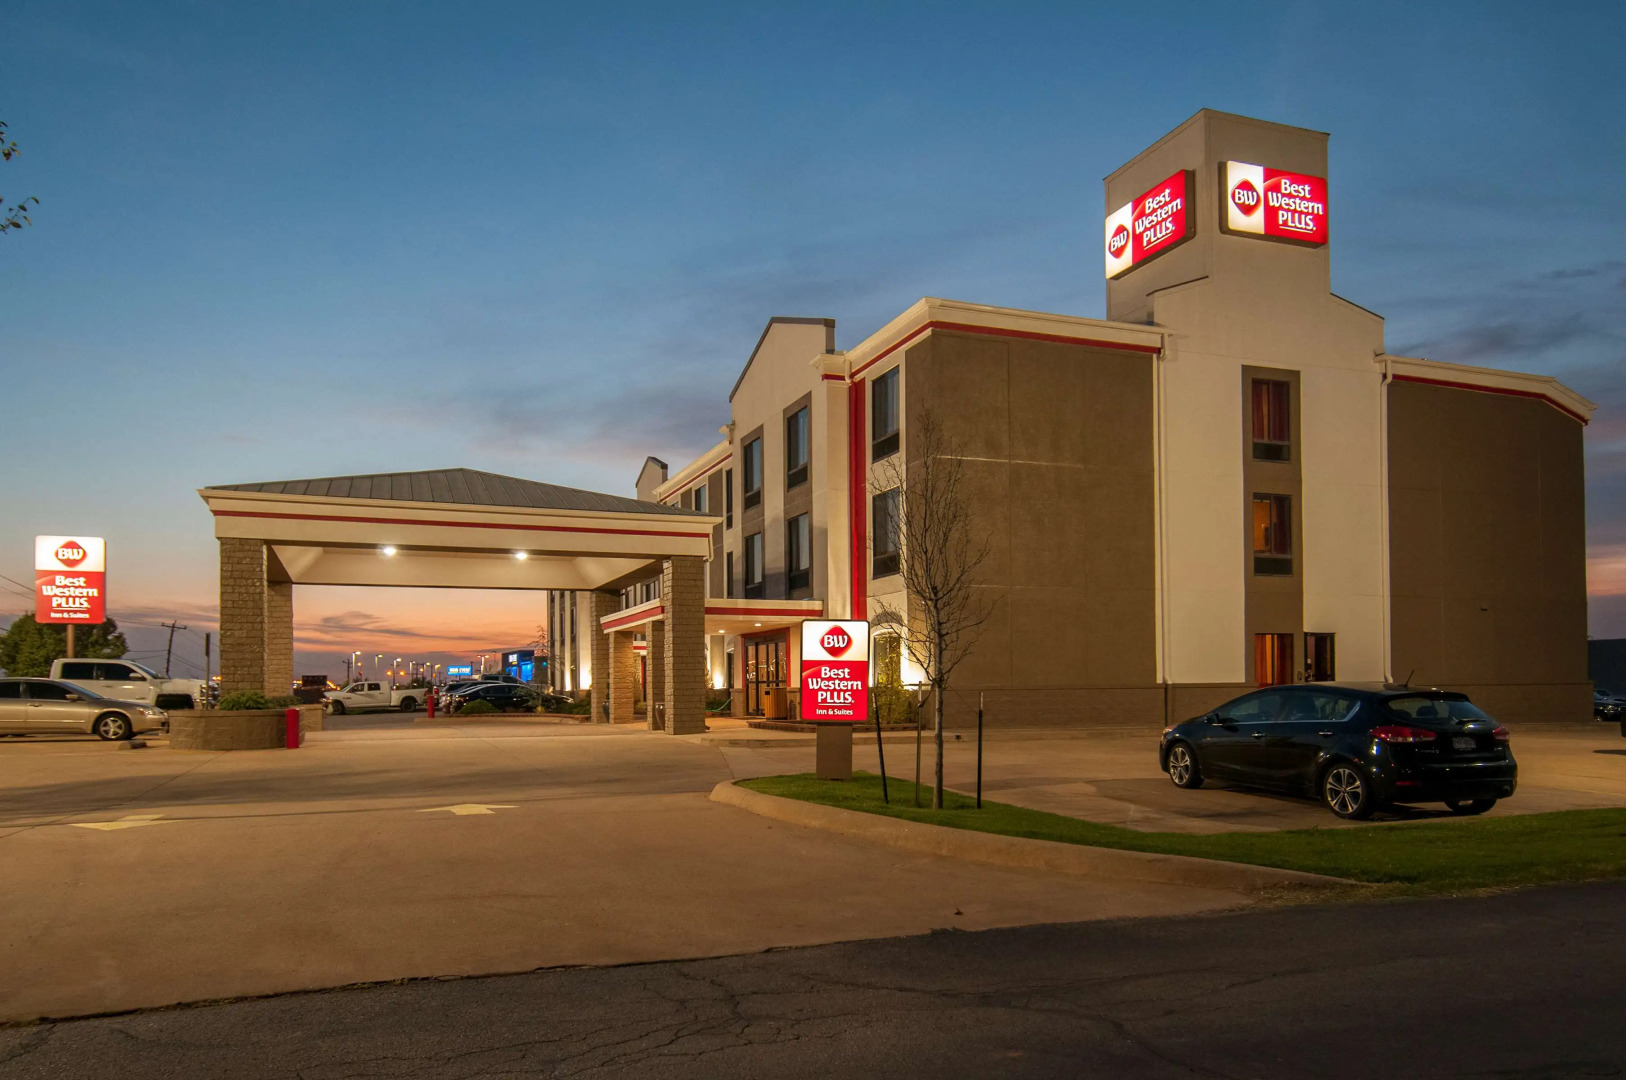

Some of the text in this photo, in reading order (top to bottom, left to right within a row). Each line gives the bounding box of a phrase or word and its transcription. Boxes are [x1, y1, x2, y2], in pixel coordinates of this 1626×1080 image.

[1281, 179, 1311, 198] Best
[1145, 188, 1170, 214] Best
[1235, 189, 1257, 205] BW
[1268, 191, 1323, 215] Western
[1135, 198, 1181, 235] Western
[1110, 231, 1127, 252] BW
[57, 548, 84, 560] BW
[55, 575, 86, 586] Best
[42, 585, 98, 597] Western
[824, 635, 848, 647] BW
[821, 666, 850, 678] Best
[808, 678, 862, 690] Western
